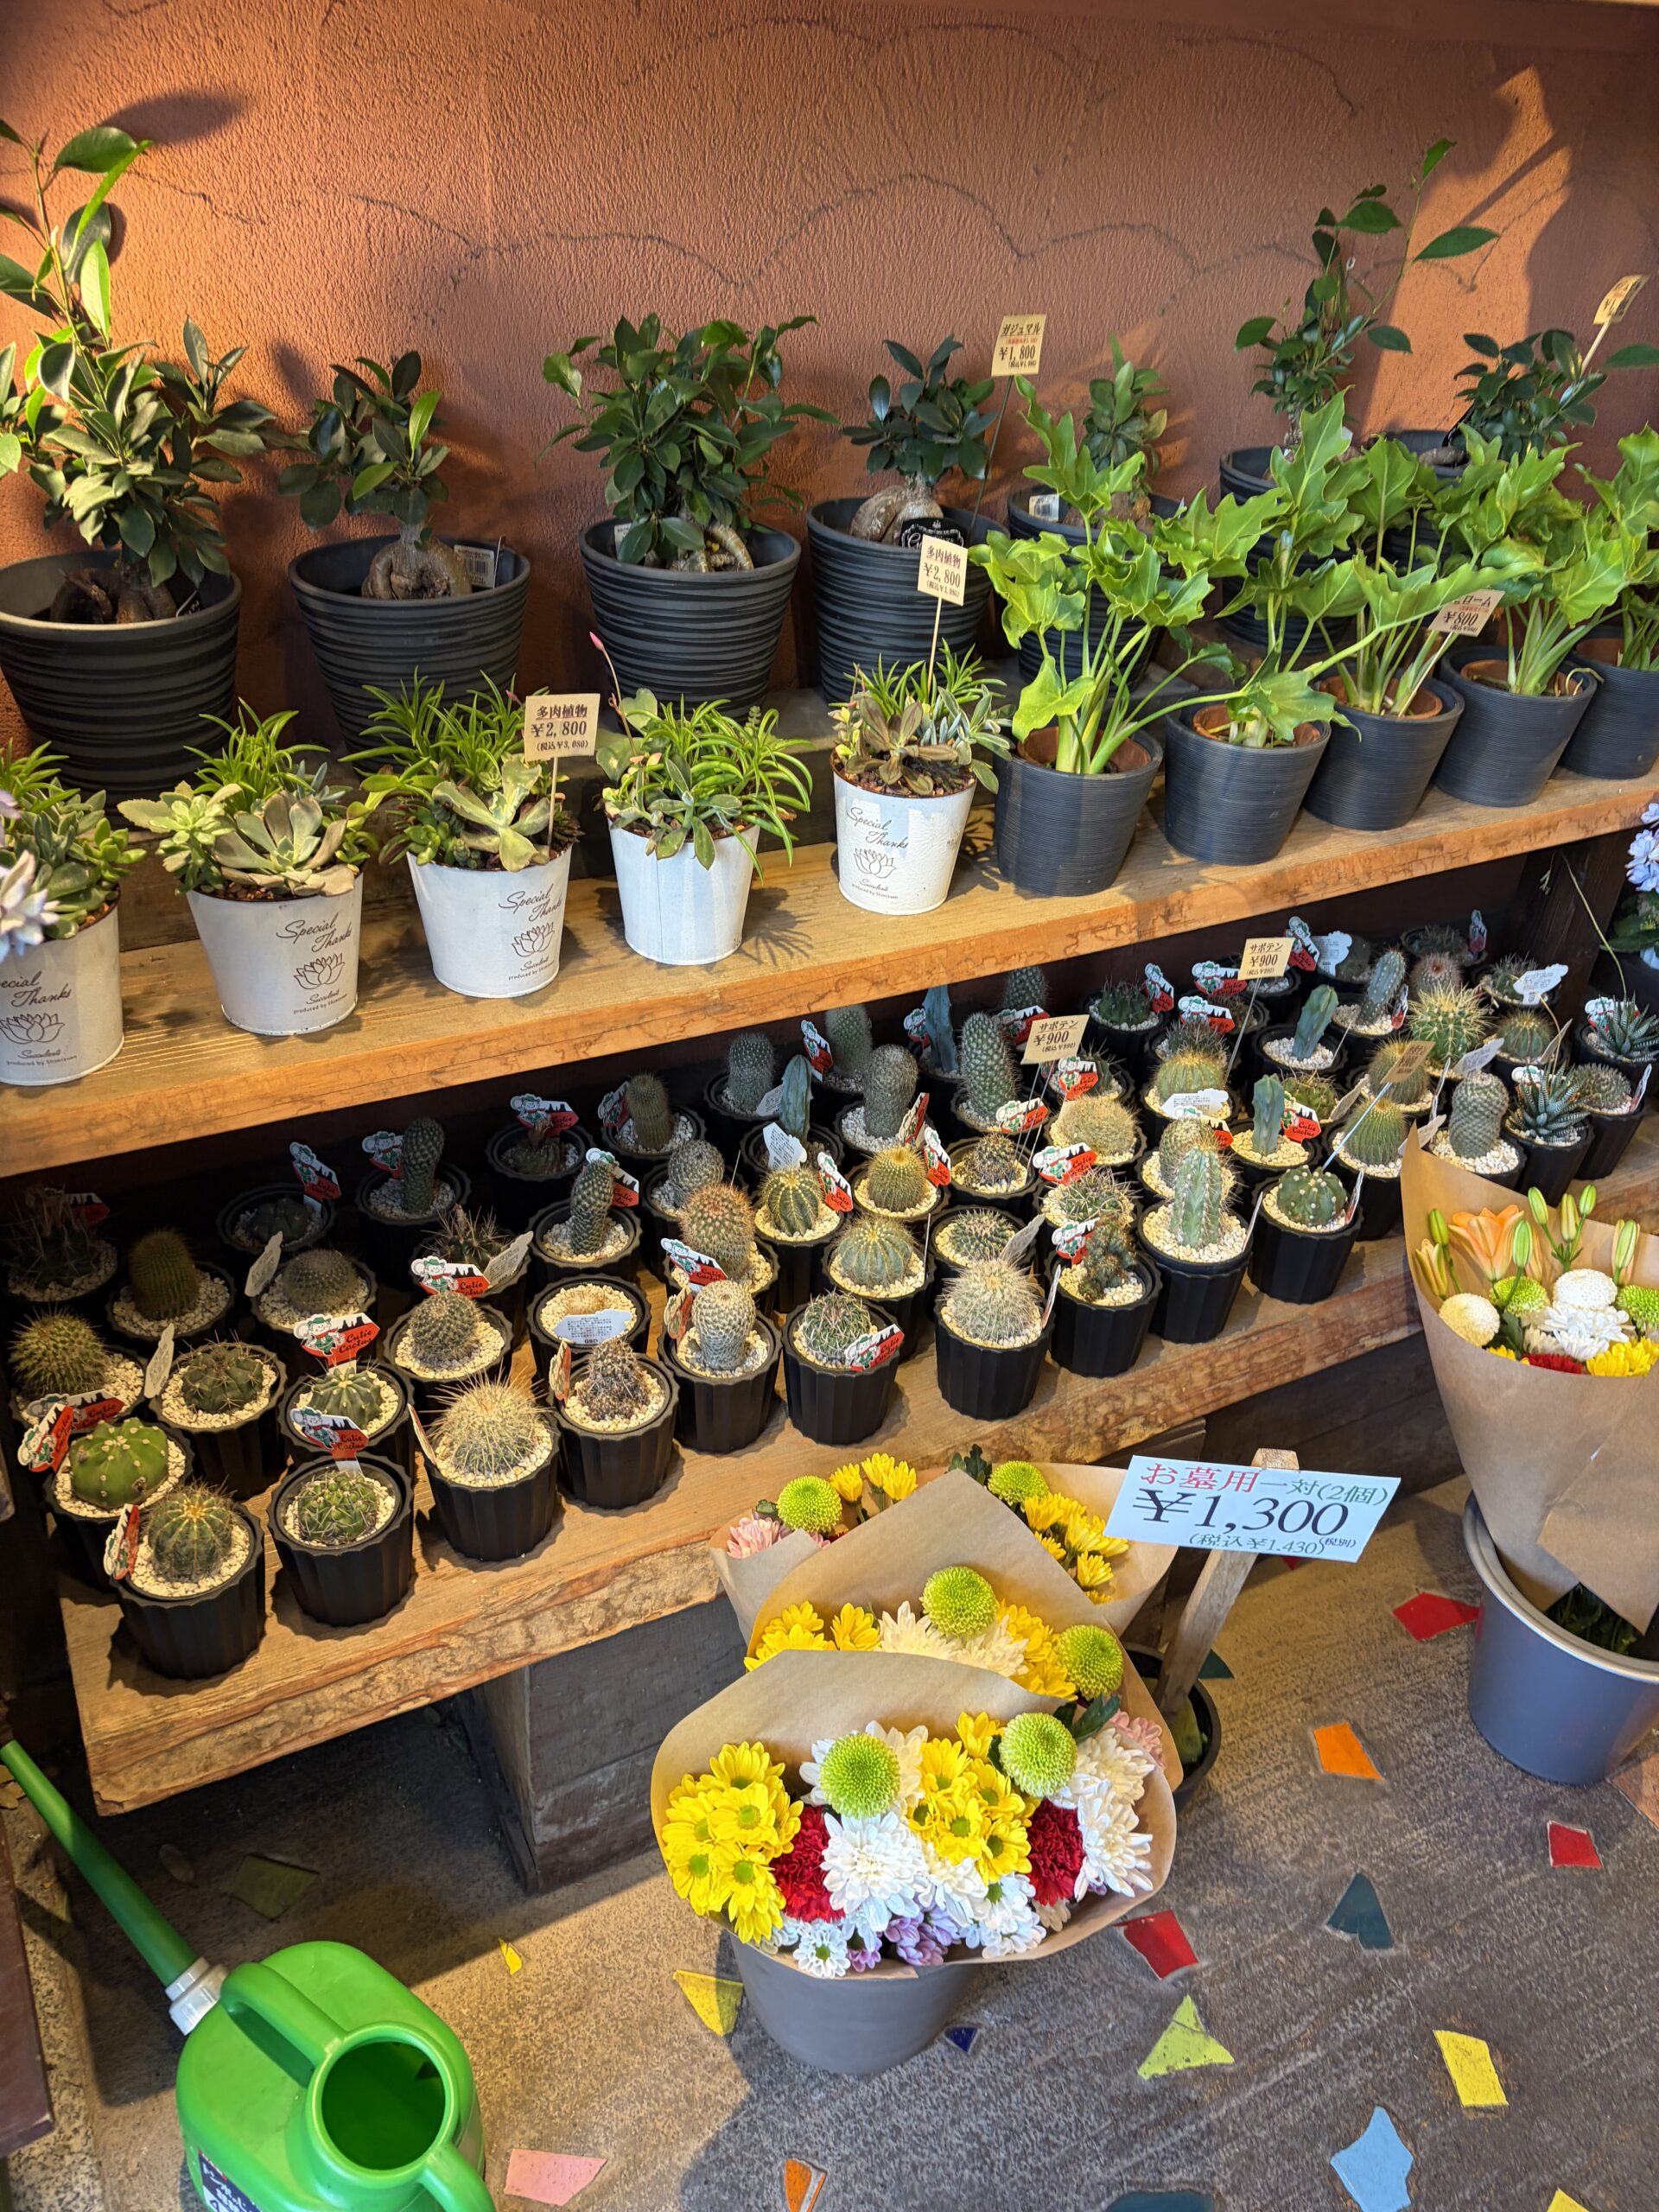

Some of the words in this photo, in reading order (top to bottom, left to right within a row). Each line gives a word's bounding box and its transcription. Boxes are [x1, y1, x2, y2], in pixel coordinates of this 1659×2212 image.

[1002, 322, 1041, 336] ガジュマル
[999, 346, 1036, 360] ¥1,800
[926, 545, 961, 569] 多肉植物
[924, 562, 961, 588] ¥2,800
[1444, 611, 1478, 626] ¥800
[536, 704, 588, 719] 多肉植物
[531, 721, 587, 737] ¥2,800
[846, 806, 893, 830] Special
[865, 830, 909, 849] Thanks
[498, 883, 554, 914] Special
[276, 912, 339, 944] Special
[1249, 954, 1278, 967] ¥900
[0, 970, 41, 988] ecial
[10, 982, 73, 1007] Thanks
[1033, 1032, 1069, 1046] ¥900
[1293, 1127, 1314, 1137] Cactus
[1299, 1122, 1316, 1132] Cutie
[460, 1281, 483, 1290] Cutie
[346, 1329, 372, 1343] Cutie
[339, 1338, 372, 1353] Cactus
[88, 1404, 117, 1417] Cutie
[1133, 1487, 1349, 1535] ¥1,300
